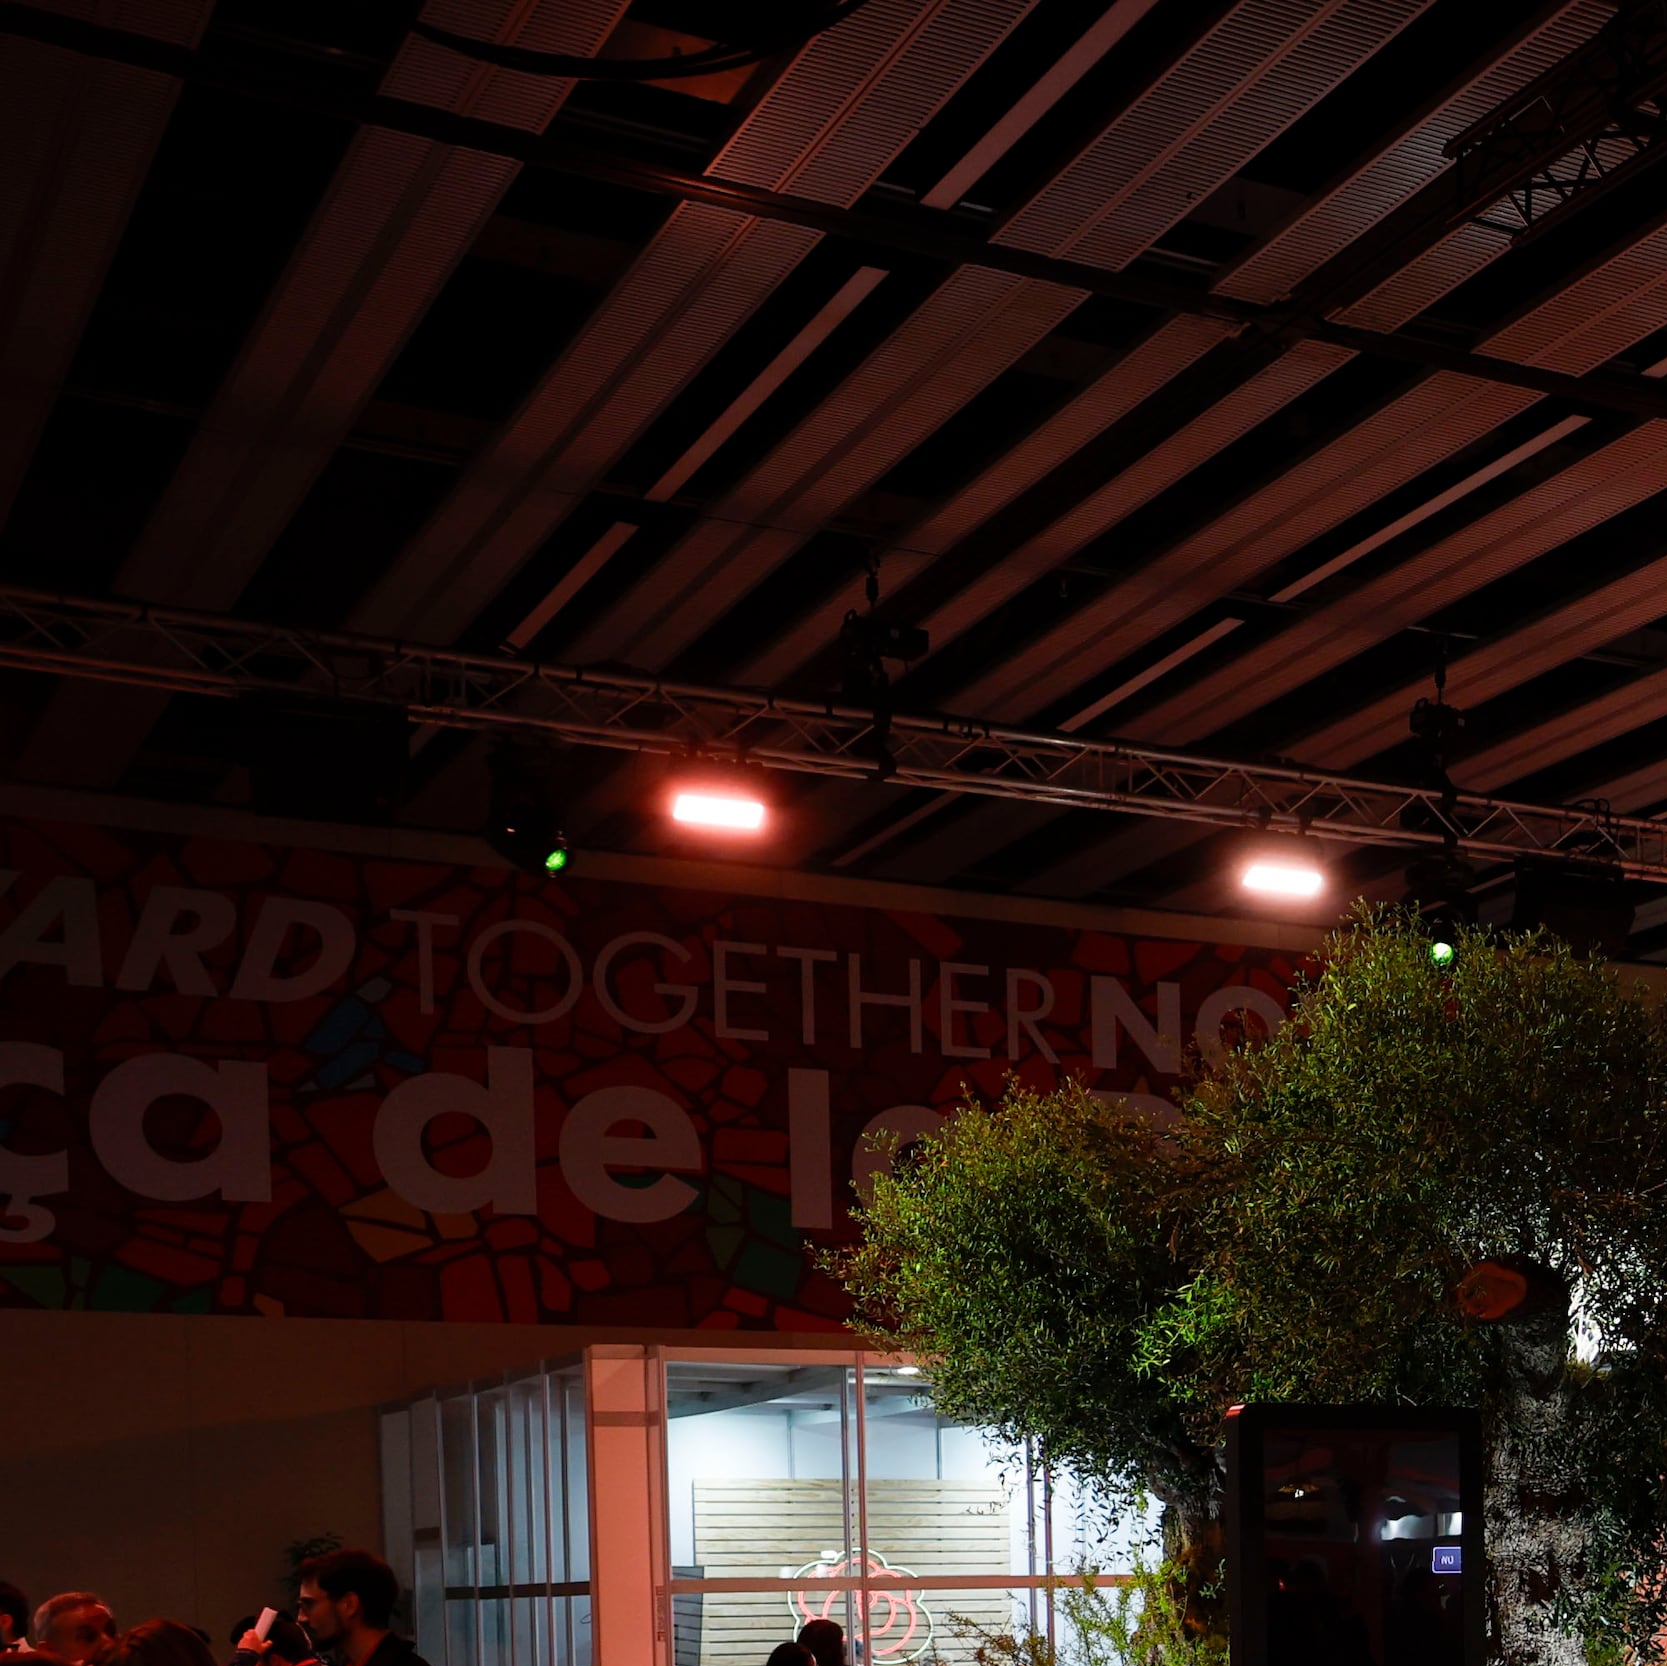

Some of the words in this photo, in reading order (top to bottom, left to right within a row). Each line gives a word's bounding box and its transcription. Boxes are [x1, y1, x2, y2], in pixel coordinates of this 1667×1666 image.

[0, 868, 357, 1003] ARD
[388, 907, 1061, 1066] TOGETHER
[372, 1045, 702, 1225] de
